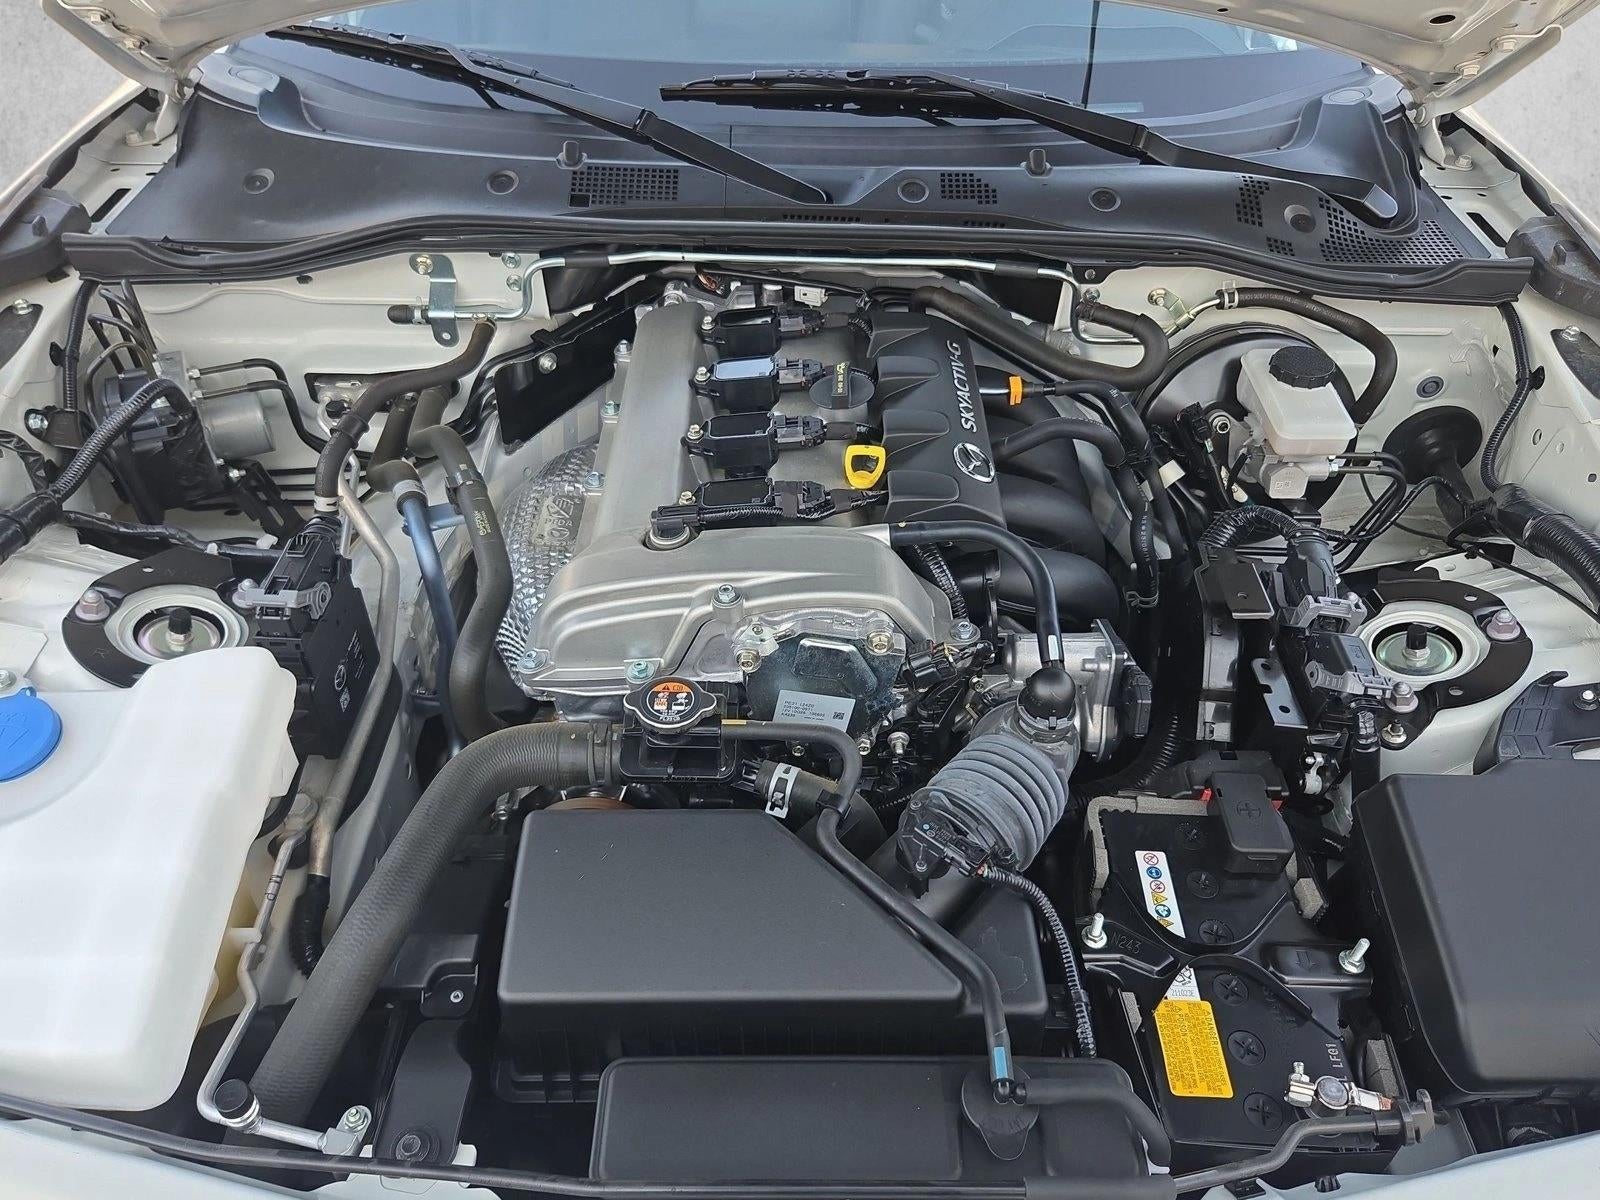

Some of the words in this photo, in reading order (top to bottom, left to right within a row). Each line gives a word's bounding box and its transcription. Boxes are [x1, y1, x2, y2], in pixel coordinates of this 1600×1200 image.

[946, 339, 978, 433] SKYACTIV-G
[1111, 931, 1142, 954] N243
[1204, 1018, 1218, 1045] DANGER
